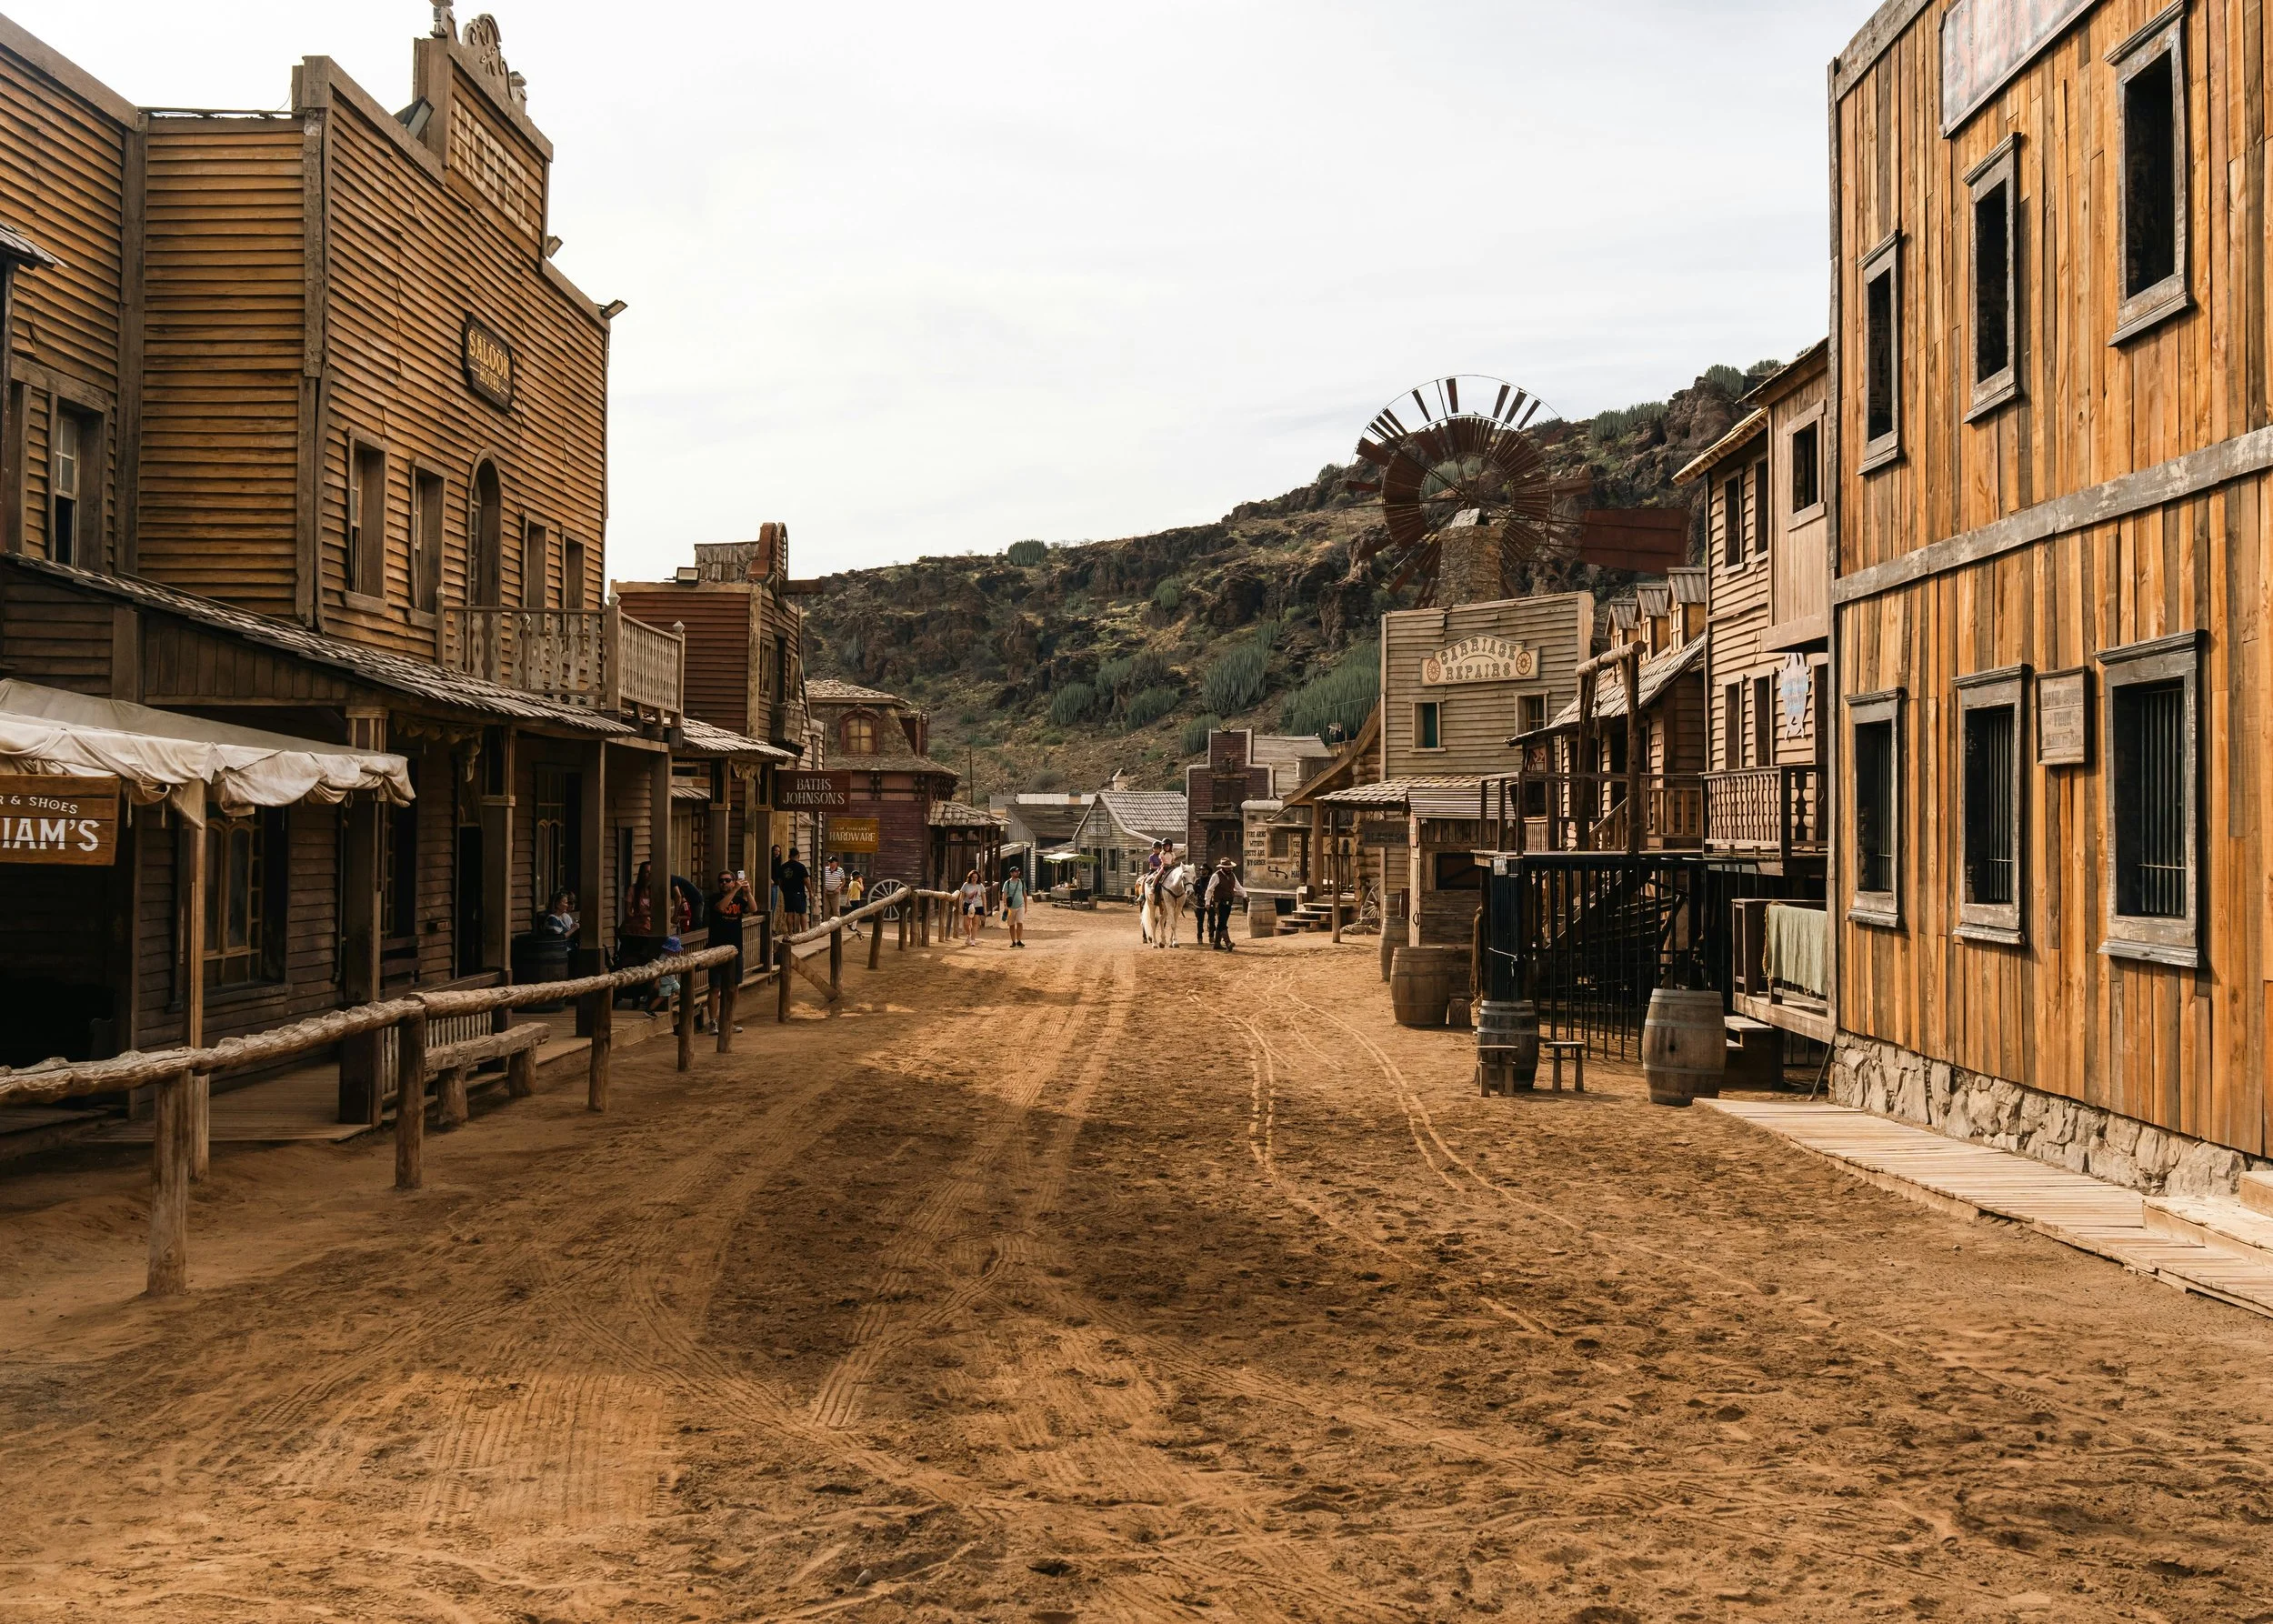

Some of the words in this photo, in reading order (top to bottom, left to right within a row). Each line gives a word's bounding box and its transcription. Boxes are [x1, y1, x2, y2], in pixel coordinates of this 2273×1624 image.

[455, 100, 533, 236] HOTEL
[468, 329, 509, 381] SALOON
[479, 365, 500, 393] HOTEL
[1440, 637, 1517, 665] CARRIAGE
[1446, 662, 1510, 680] REPAIRS
[796, 778, 832, 790] BATHS
[10, 796, 21, 805] &
[29, 797, 78, 814] SHOES
[783, 792, 845, 805] JOHNSON'S
[2, 818, 100, 852] IAM'S
[829, 831, 876, 842] HARDWARE
